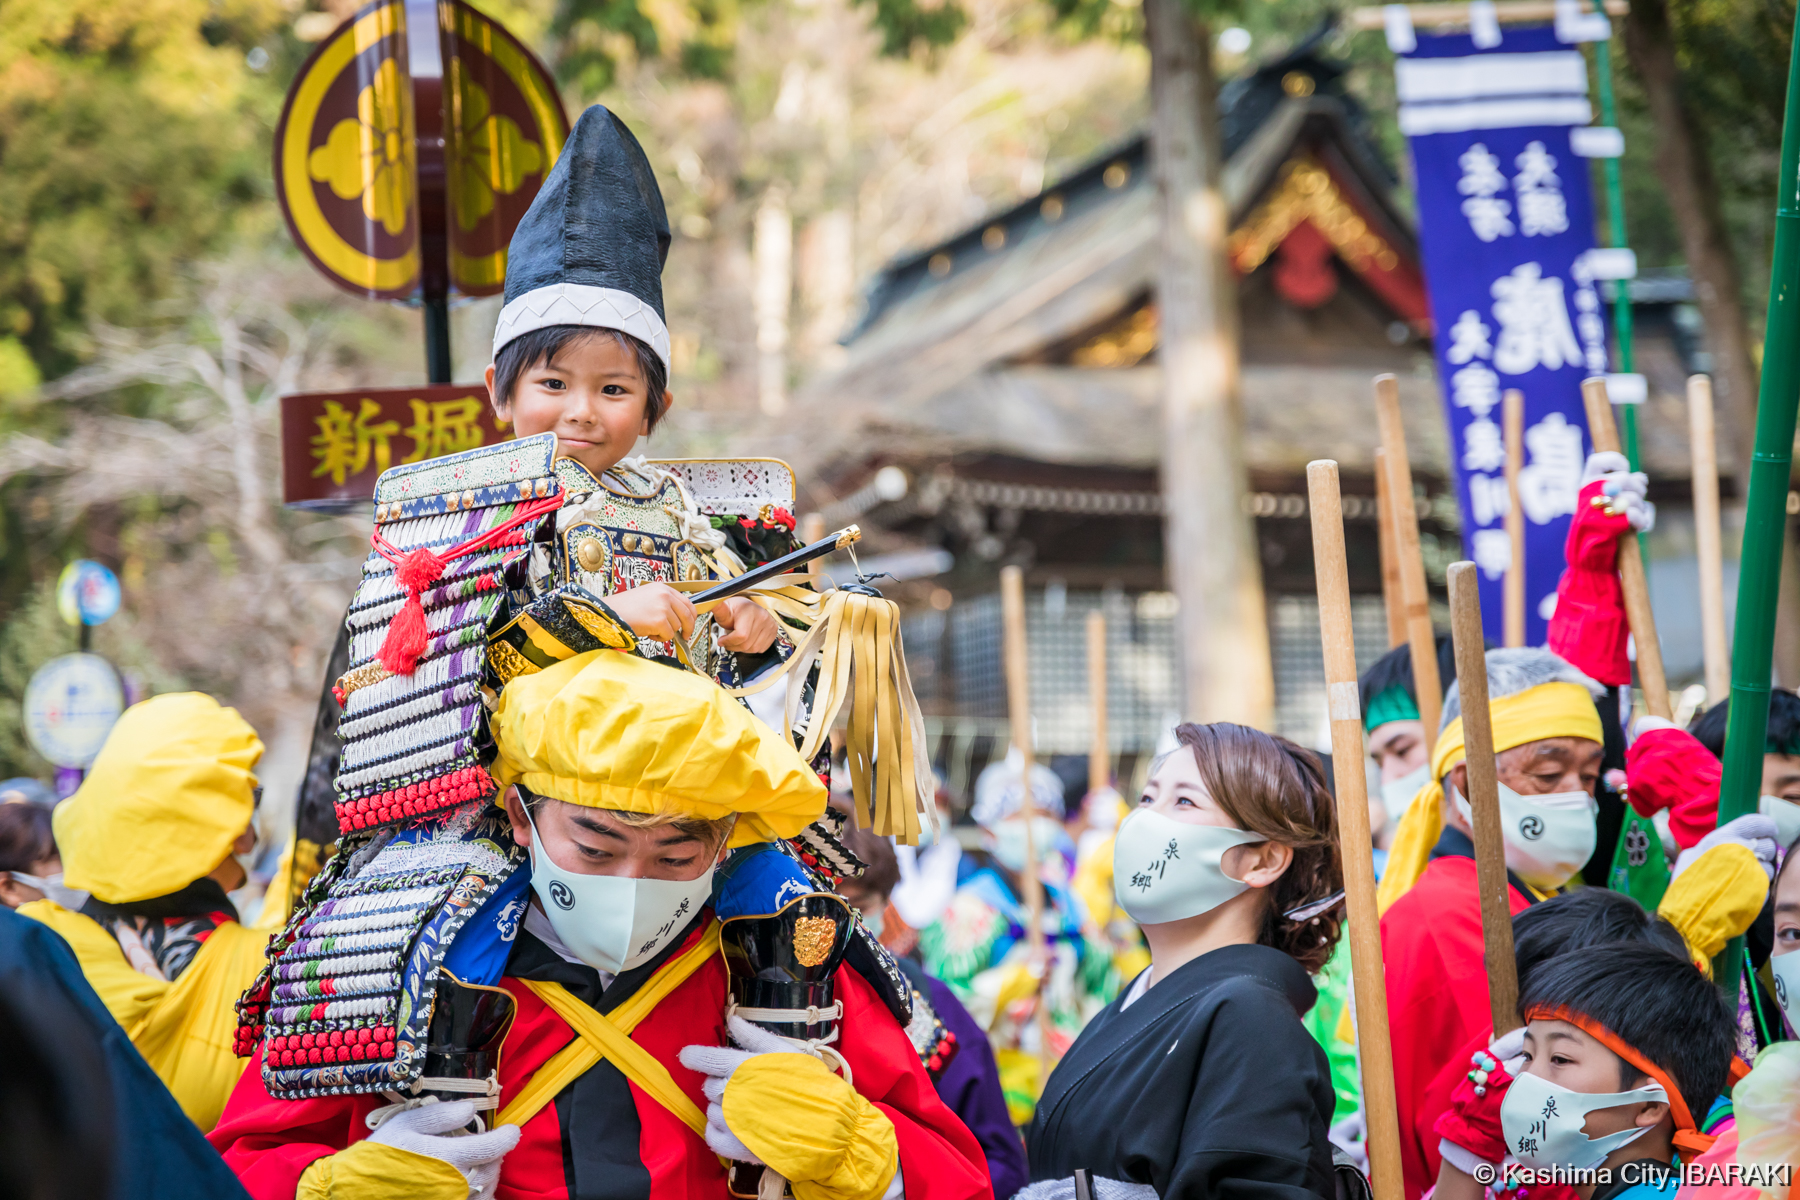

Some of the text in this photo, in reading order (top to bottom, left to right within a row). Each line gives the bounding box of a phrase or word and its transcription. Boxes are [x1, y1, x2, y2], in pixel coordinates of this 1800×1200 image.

[310, 395, 512, 486] 新堀
[1129, 838, 1181, 893] 泉川郷
[635, 897, 690, 957] 泉川郷
[1517, 1095, 1561, 1158] 泉川郷
